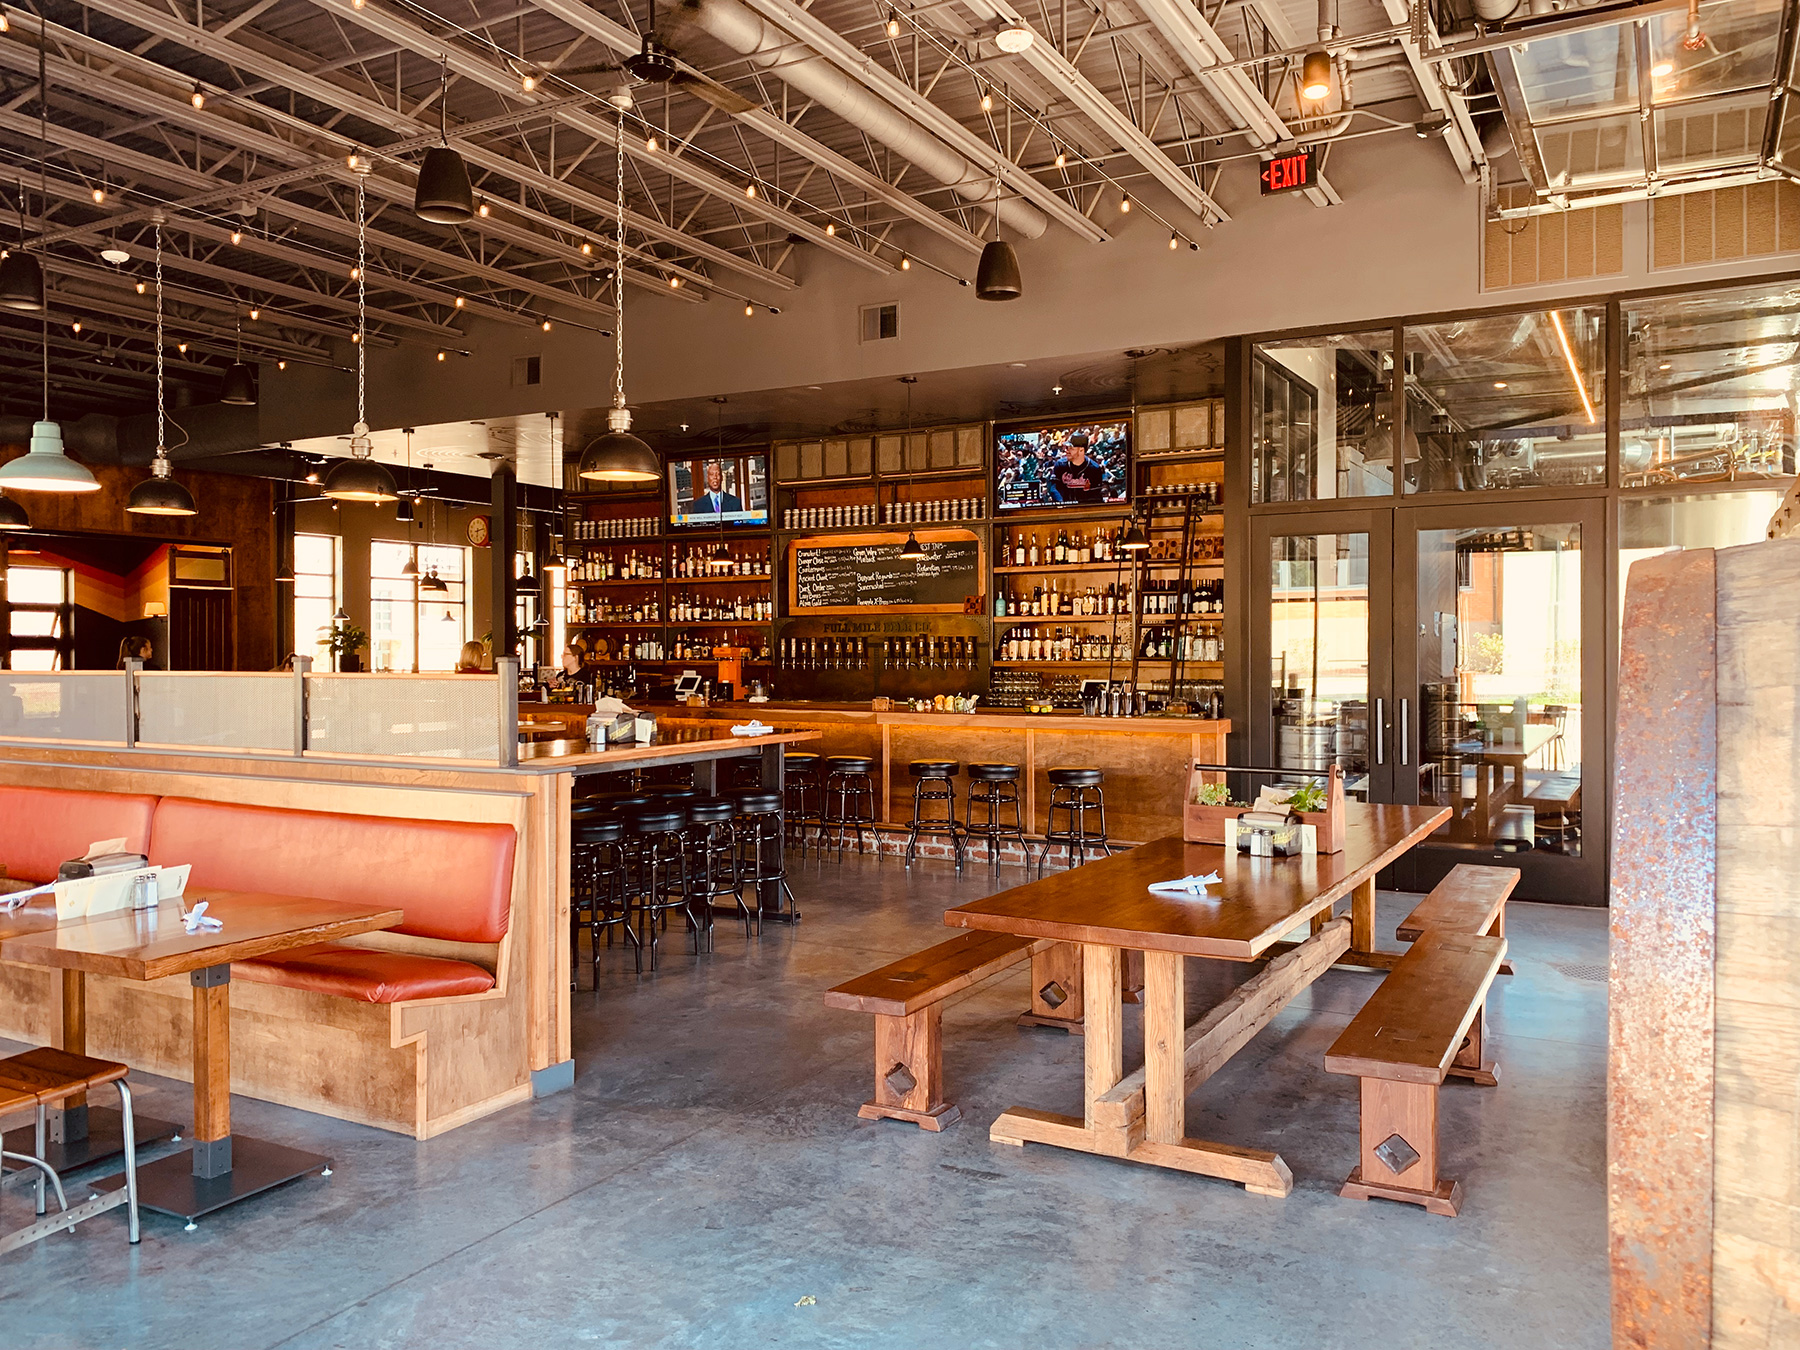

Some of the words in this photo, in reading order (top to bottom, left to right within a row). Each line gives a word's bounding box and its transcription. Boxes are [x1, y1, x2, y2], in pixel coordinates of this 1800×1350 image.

[1270, 154, 1308, 190] EXIT
[823, 622, 851, 633] FULL
[852, 622, 880, 633] MILE
